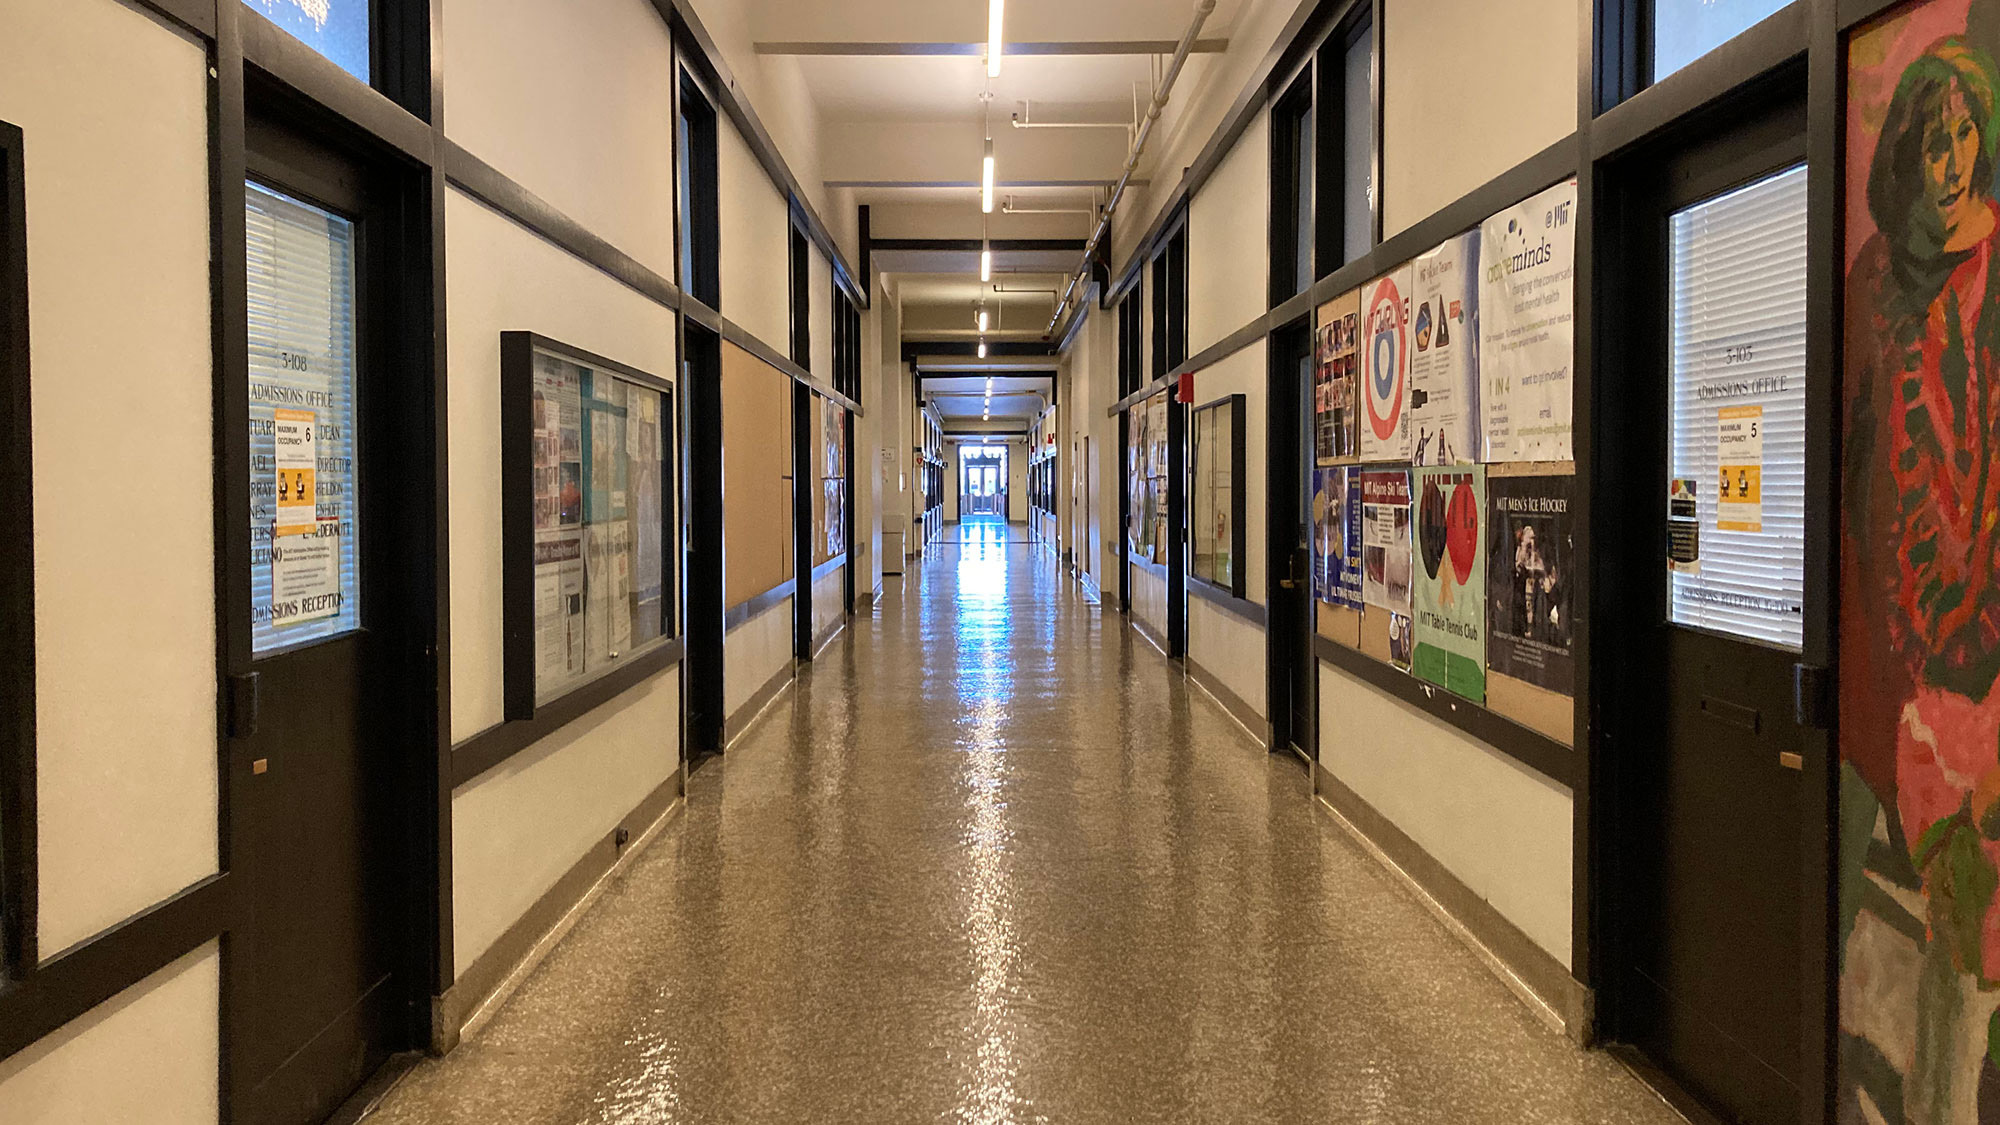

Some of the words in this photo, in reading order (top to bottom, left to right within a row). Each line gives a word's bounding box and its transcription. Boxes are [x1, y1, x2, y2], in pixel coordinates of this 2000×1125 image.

[1376, 296, 1410, 336] CURLING
[281, 352, 308, 372] 3-108
[1496, 377, 1504, 396] IN
[1696, 380, 1748, 400] ADMISSIONS
[1752, 375, 1788, 396] OFFICE
[251, 384, 304, 404] ADMISSIONS
[306, 390, 334, 408] OFFICE
[277, 425, 298, 434] MAXIMUM
[305, 427, 311, 442] 6
[320, 424, 340, 440] DEAN
[1720, 424, 1742, 432] MAXIMUM
[1750, 422, 1758, 438] 5
[277, 437, 303, 446] OCCUPANCY
[1720, 434, 1748, 444] OCCUPANCY
[316, 457, 352, 473] DIRECTOR
[1364, 481, 1372, 496] MIT
[1373, 482, 1386, 498] Alpine
[1388, 481, 1396, 496] Ski
[1496, 496, 1508, 511] MIT
[302, 590, 346, 615] RECEPTION
[1420, 610, 1430, 626] MIT
[1432, 612, 1445, 632] Table
[1446, 618, 1464, 638] Tennis
[1464, 622, 1478, 642] Club
